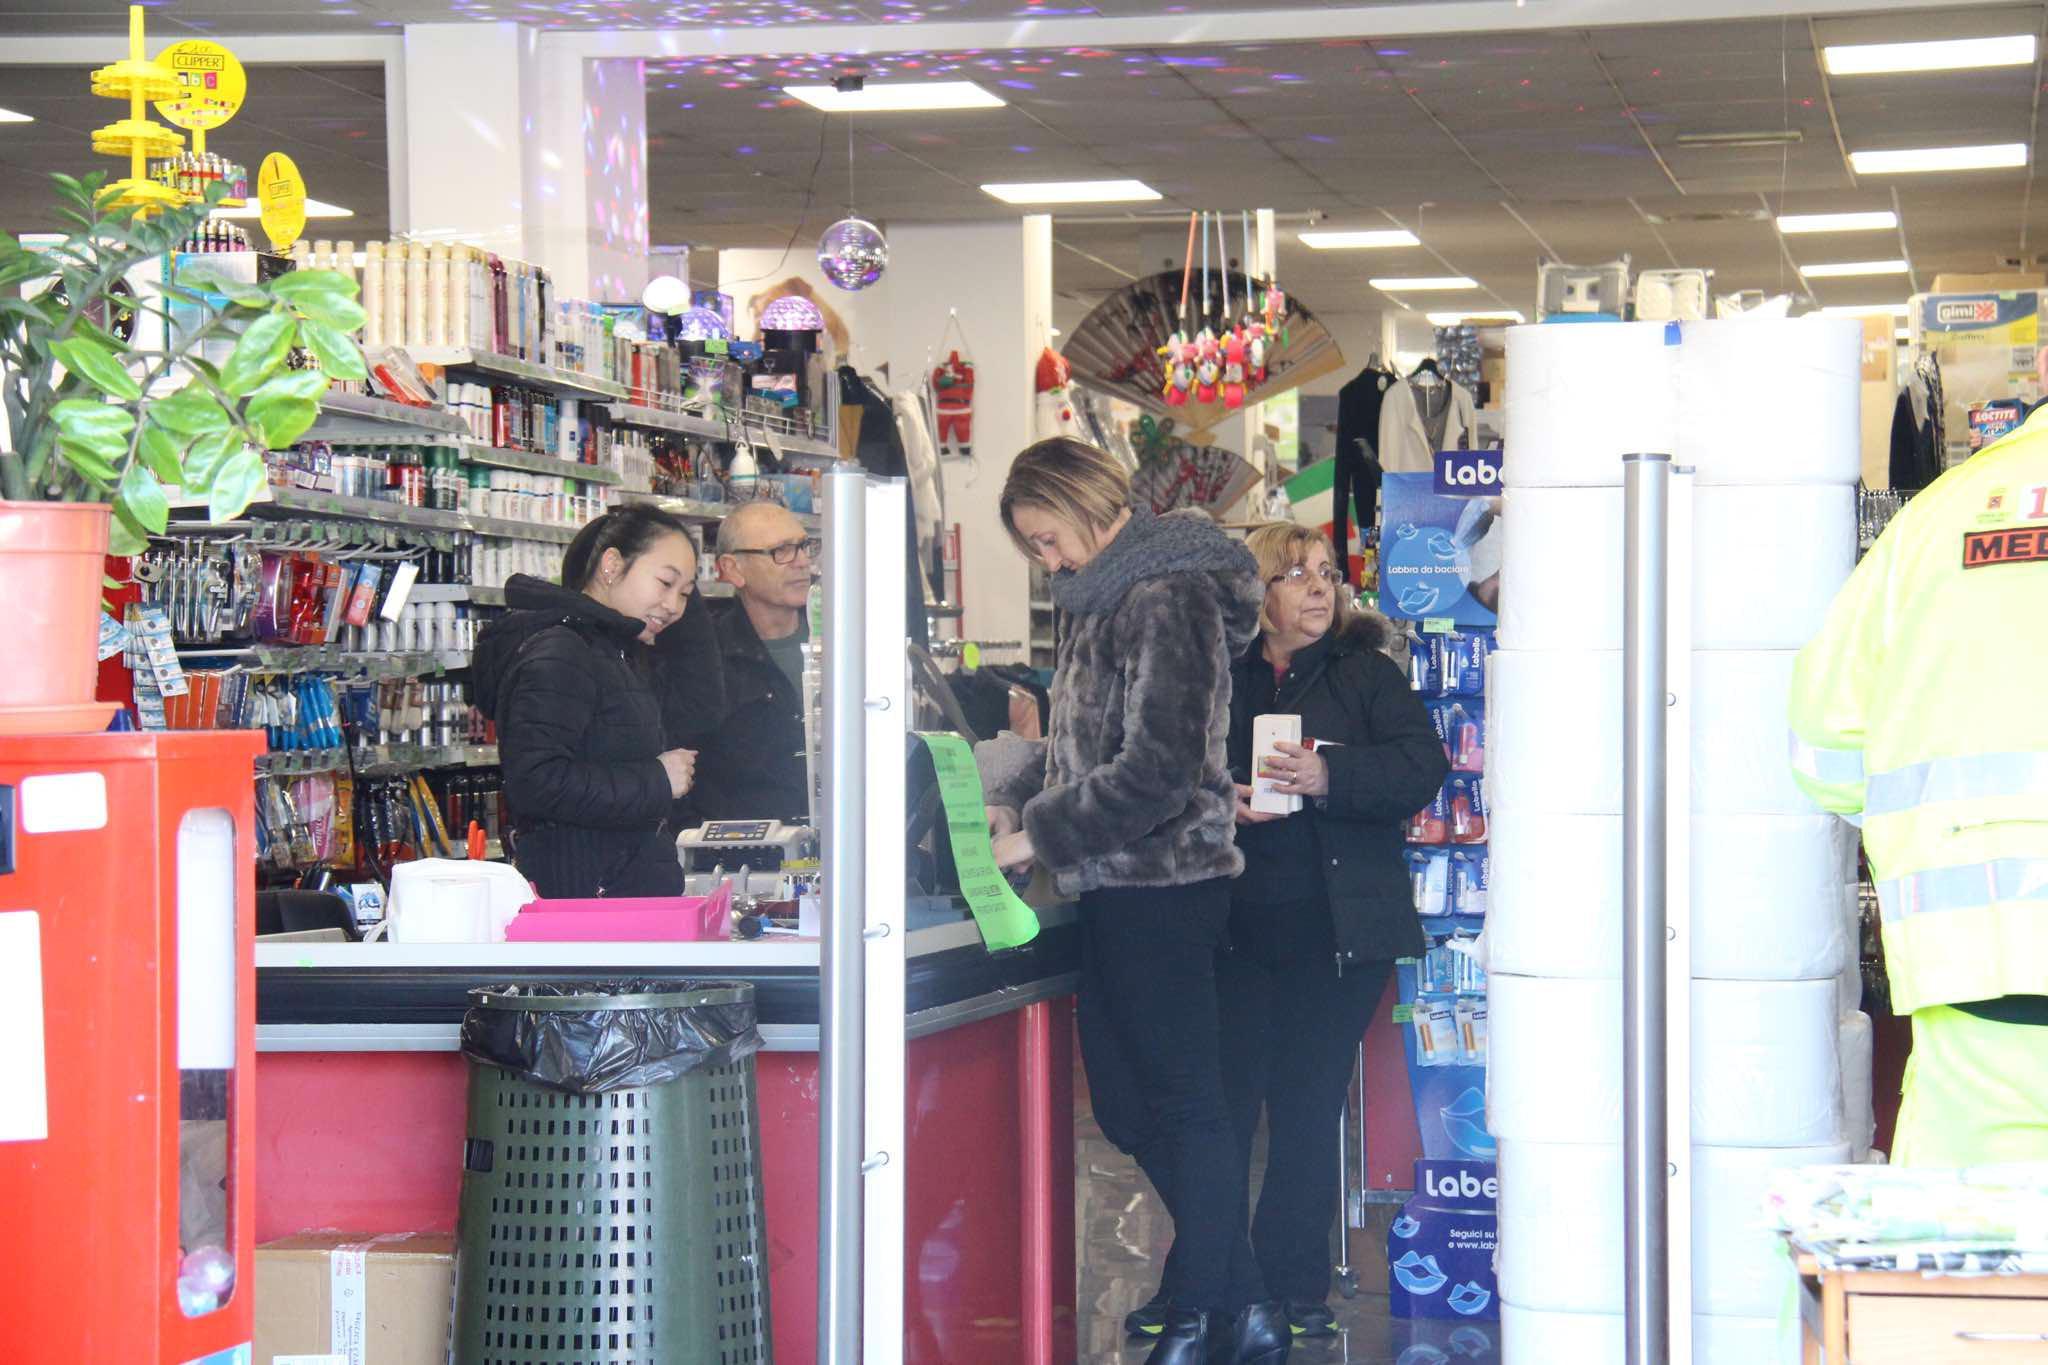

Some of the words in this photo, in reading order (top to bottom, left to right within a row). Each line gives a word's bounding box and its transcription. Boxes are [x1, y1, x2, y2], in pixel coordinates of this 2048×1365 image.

[176, 55, 220, 67] CLIPPER
[1974, 409, 2017, 423] LOCTITE
[1388, 565, 1418, 574] Labbra
[1420, 565, 1433, 574] da
[1471, 636, 1480, 668] Labello
[1433, 708, 1444, 739] Labello
[1471, 780, 1480, 812] Labello
[1480, 857, 1488, 890] Labello
[1450, 1229, 1482, 1239] Seguici
